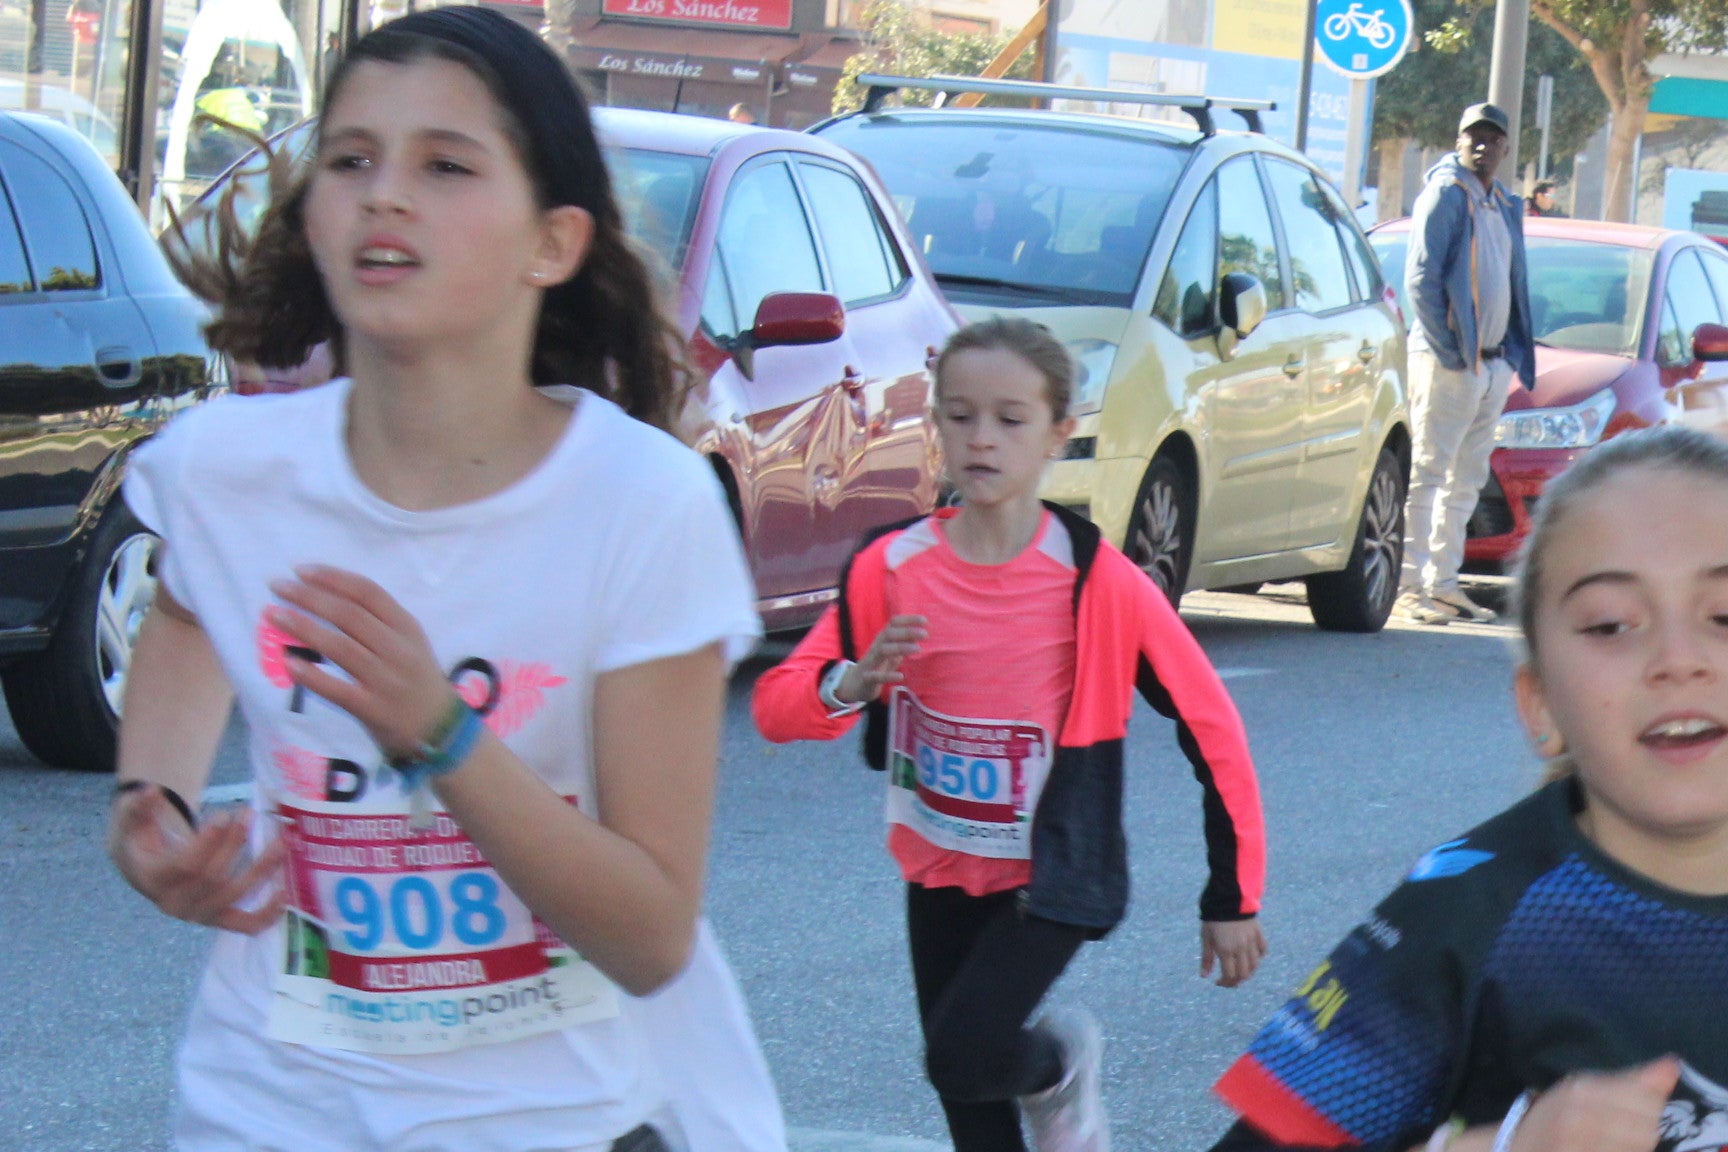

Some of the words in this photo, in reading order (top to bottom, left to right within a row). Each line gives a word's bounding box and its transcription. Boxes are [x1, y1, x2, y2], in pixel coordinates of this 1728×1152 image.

[627, 0, 662, 13] Los
[672, 0, 759, 23] Sánchez
[598, 55, 629, 70] Los
[633, 57, 703, 78] Sánchez
[920, 744, 999, 800] 950
[334, 871, 508, 951] 908
[364, 958, 488, 989] ALEJANDRA
